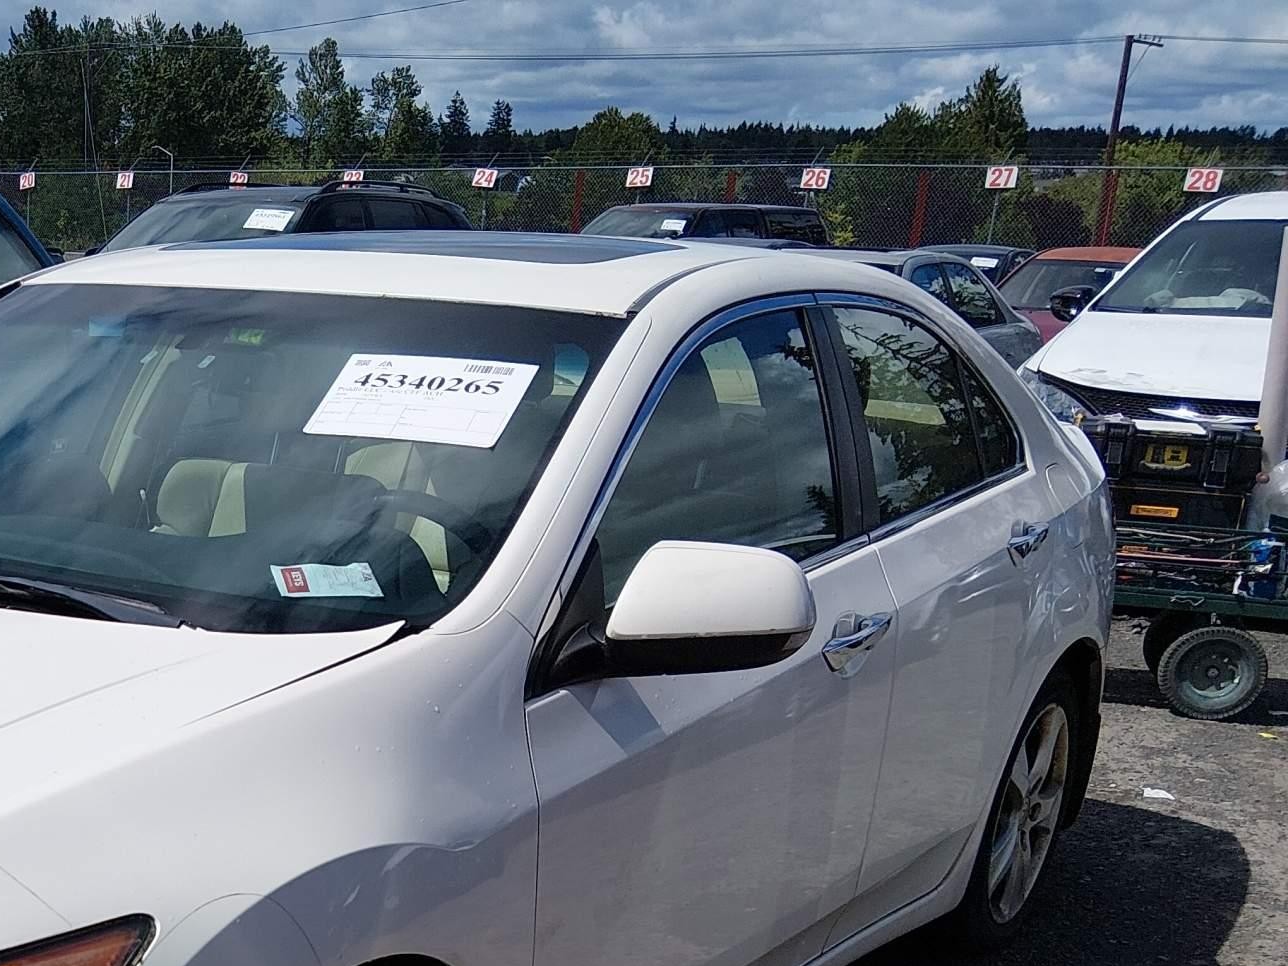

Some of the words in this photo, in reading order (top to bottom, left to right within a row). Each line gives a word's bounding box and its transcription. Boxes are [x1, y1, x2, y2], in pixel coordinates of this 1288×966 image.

[21, 174, 33, 188] 20
[119, 172, 131, 187] 21
[474, 170, 494, 186] 24
[628, 168, 650, 186] 25
[803, 169, 827, 188] 26
[989, 168, 1015, 188] 27
[1187, 170, 1218, 191] 28
[354, 372, 504, 396] 45340265
